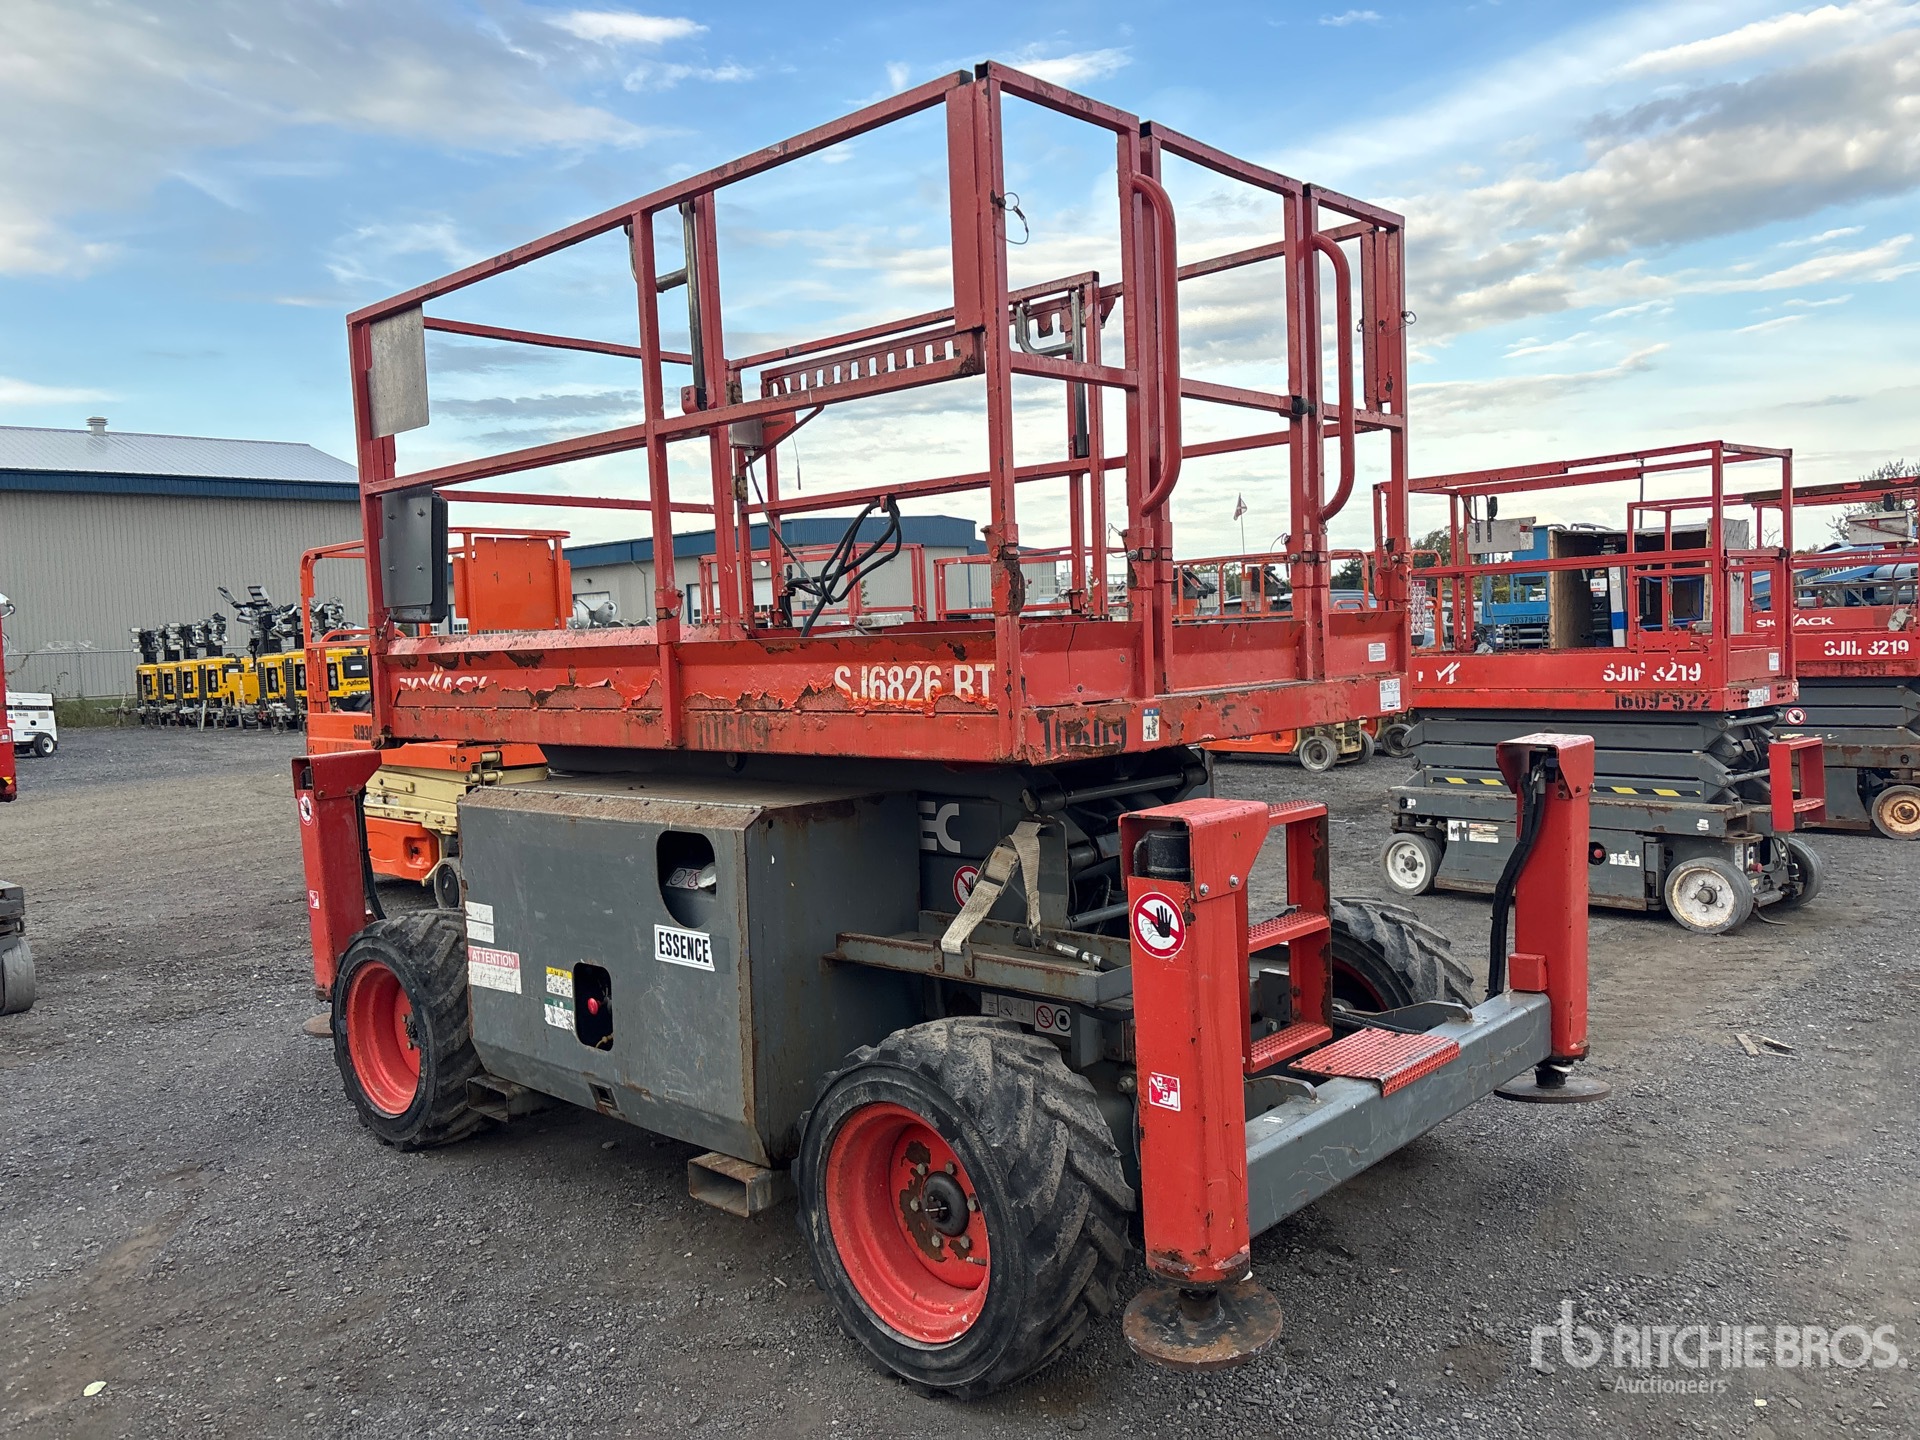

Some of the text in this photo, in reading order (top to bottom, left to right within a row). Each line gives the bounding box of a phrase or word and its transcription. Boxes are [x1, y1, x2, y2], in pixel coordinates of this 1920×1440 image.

[953, 663, 995, 700] RT
[1614, 690, 1713, 710] 1609-522
[471, 950, 515, 968] ATTENTION
[658, 931, 709, 964] ESSENCE
